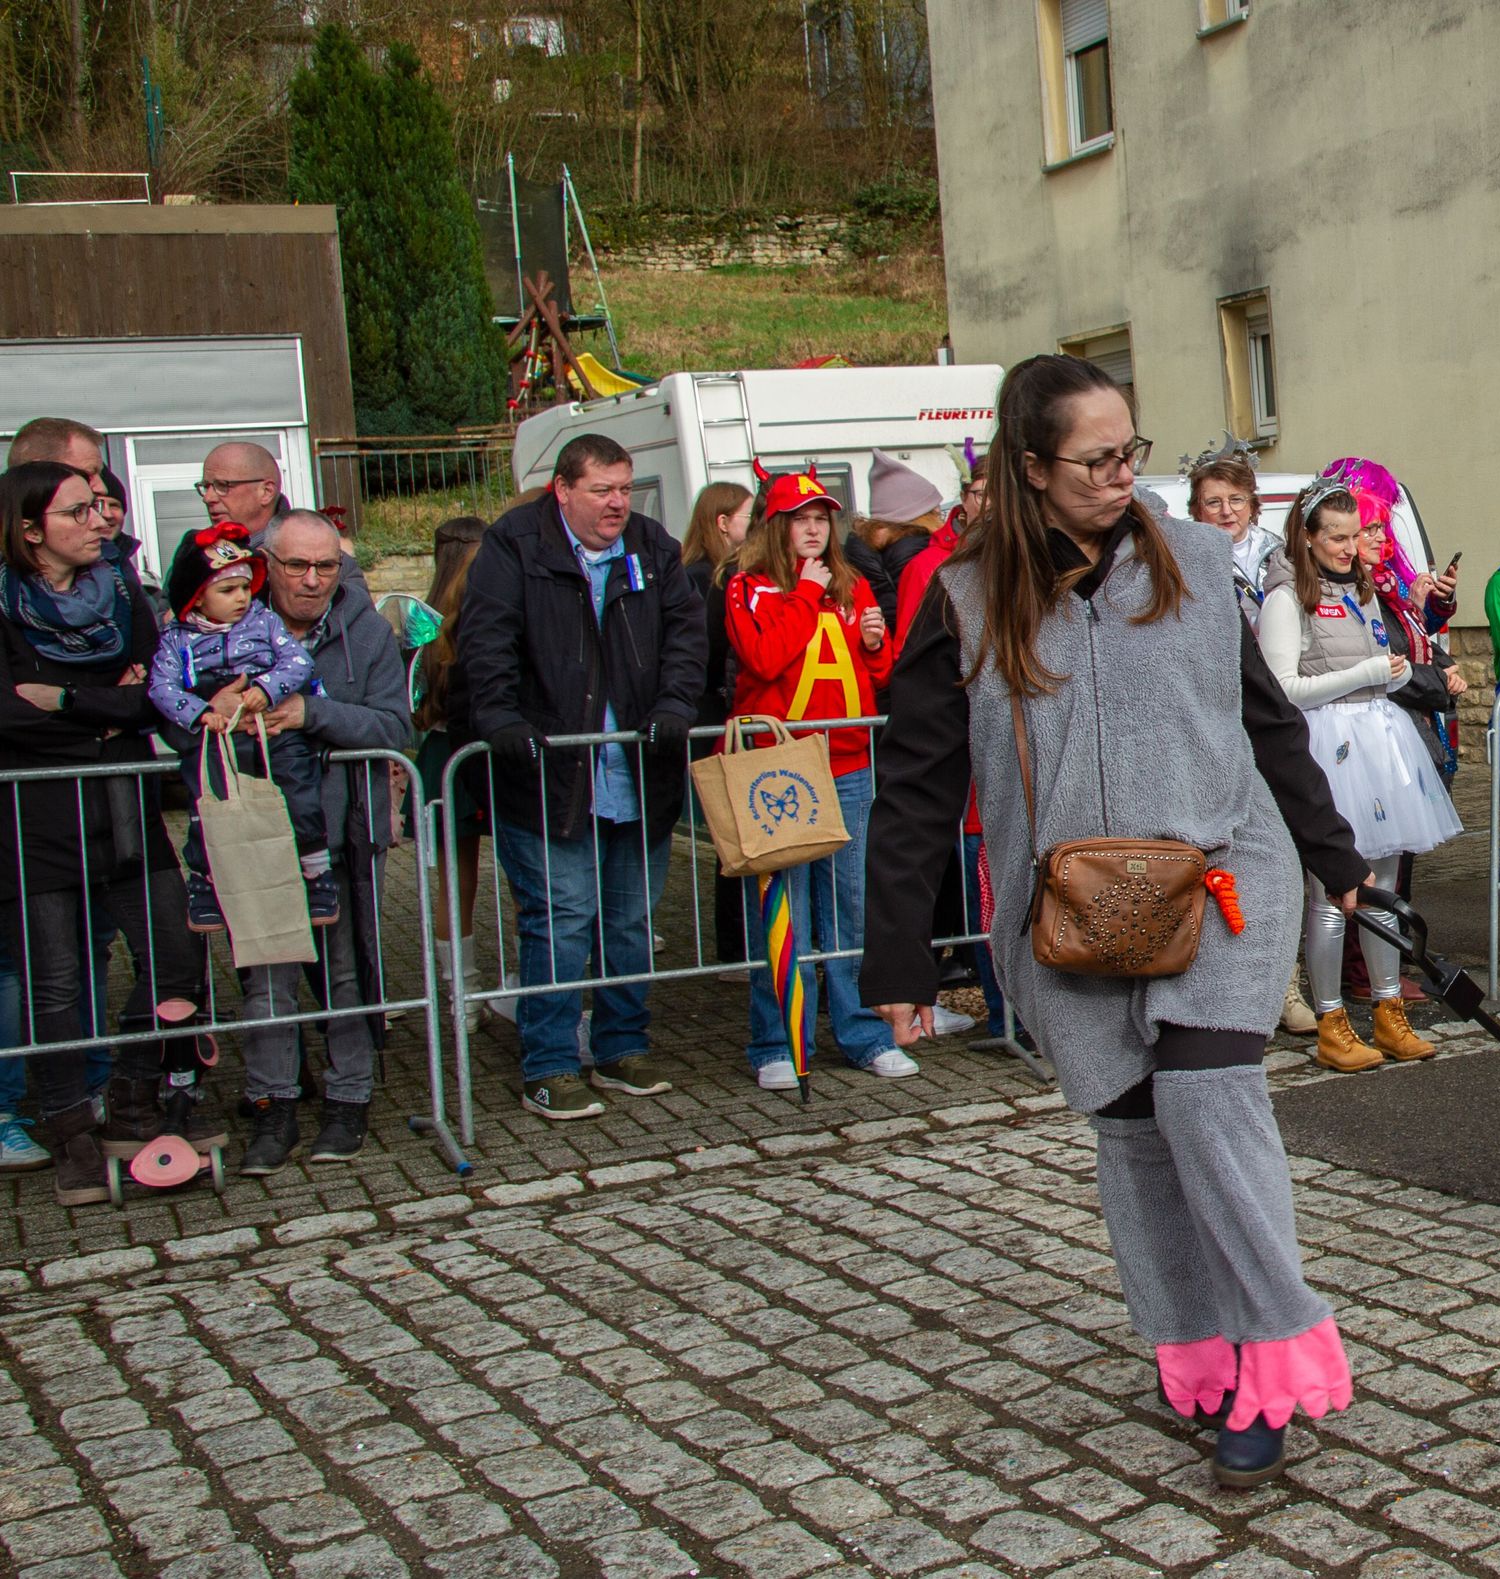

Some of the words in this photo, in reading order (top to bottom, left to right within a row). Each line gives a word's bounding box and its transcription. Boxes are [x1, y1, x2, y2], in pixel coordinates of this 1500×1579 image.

[918, 410, 994, 421] FLEURETTE
[798, 476, 824, 494] A
[1319, 607, 1342, 616] NASA
[786, 612, 861, 721] A
